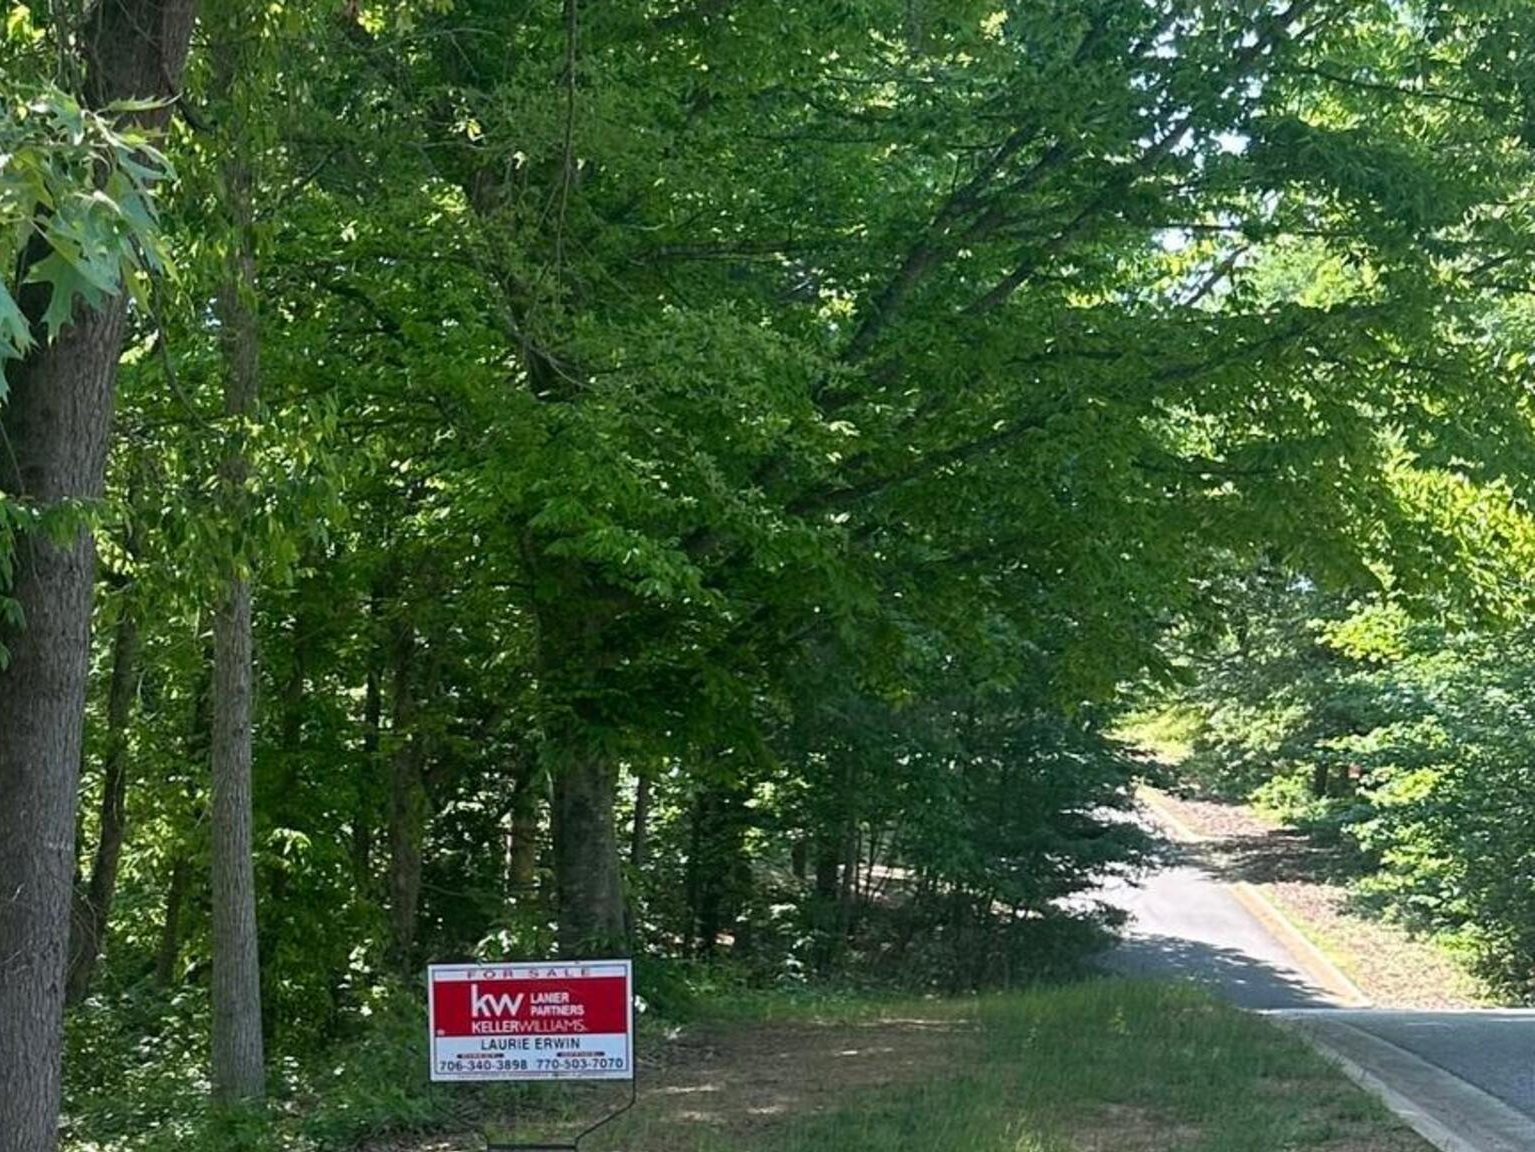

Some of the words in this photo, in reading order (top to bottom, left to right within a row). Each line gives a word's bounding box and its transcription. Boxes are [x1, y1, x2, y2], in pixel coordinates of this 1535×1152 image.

[467, 970, 513, 979] FOR
[529, 968, 590, 978] SALE
[530, 992, 569, 1004] LANIER
[530, 1005, 585, 1016] PARTNERS
[481, 1038, 530, 1050] LAURIE
[535, 1038, 580, 1049] ERWIN
[536, 1058, 623, 1070] 770-503-7070
